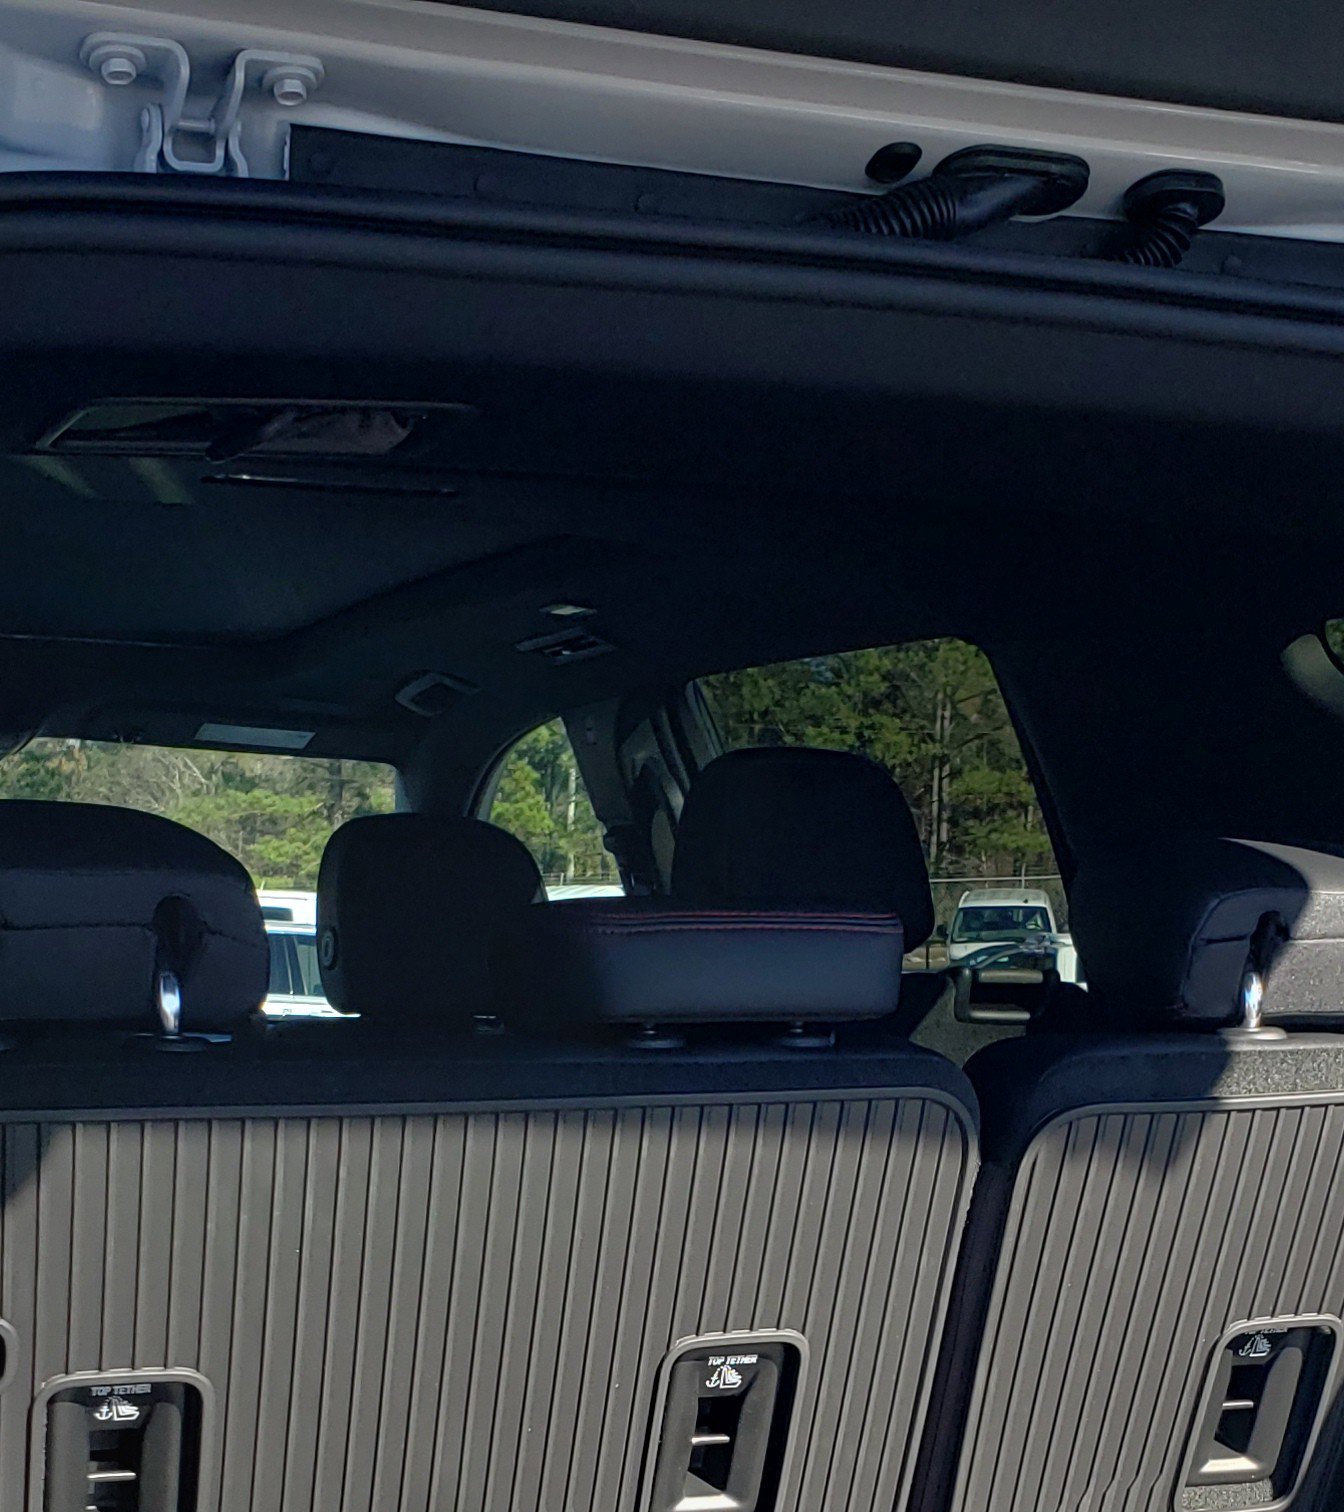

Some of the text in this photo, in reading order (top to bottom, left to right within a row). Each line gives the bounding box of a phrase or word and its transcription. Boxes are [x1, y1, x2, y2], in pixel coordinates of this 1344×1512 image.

[708, 1354, 758, 1366] TOP TETHER
[90, 1383, 152, 1397] TOP TETHER
